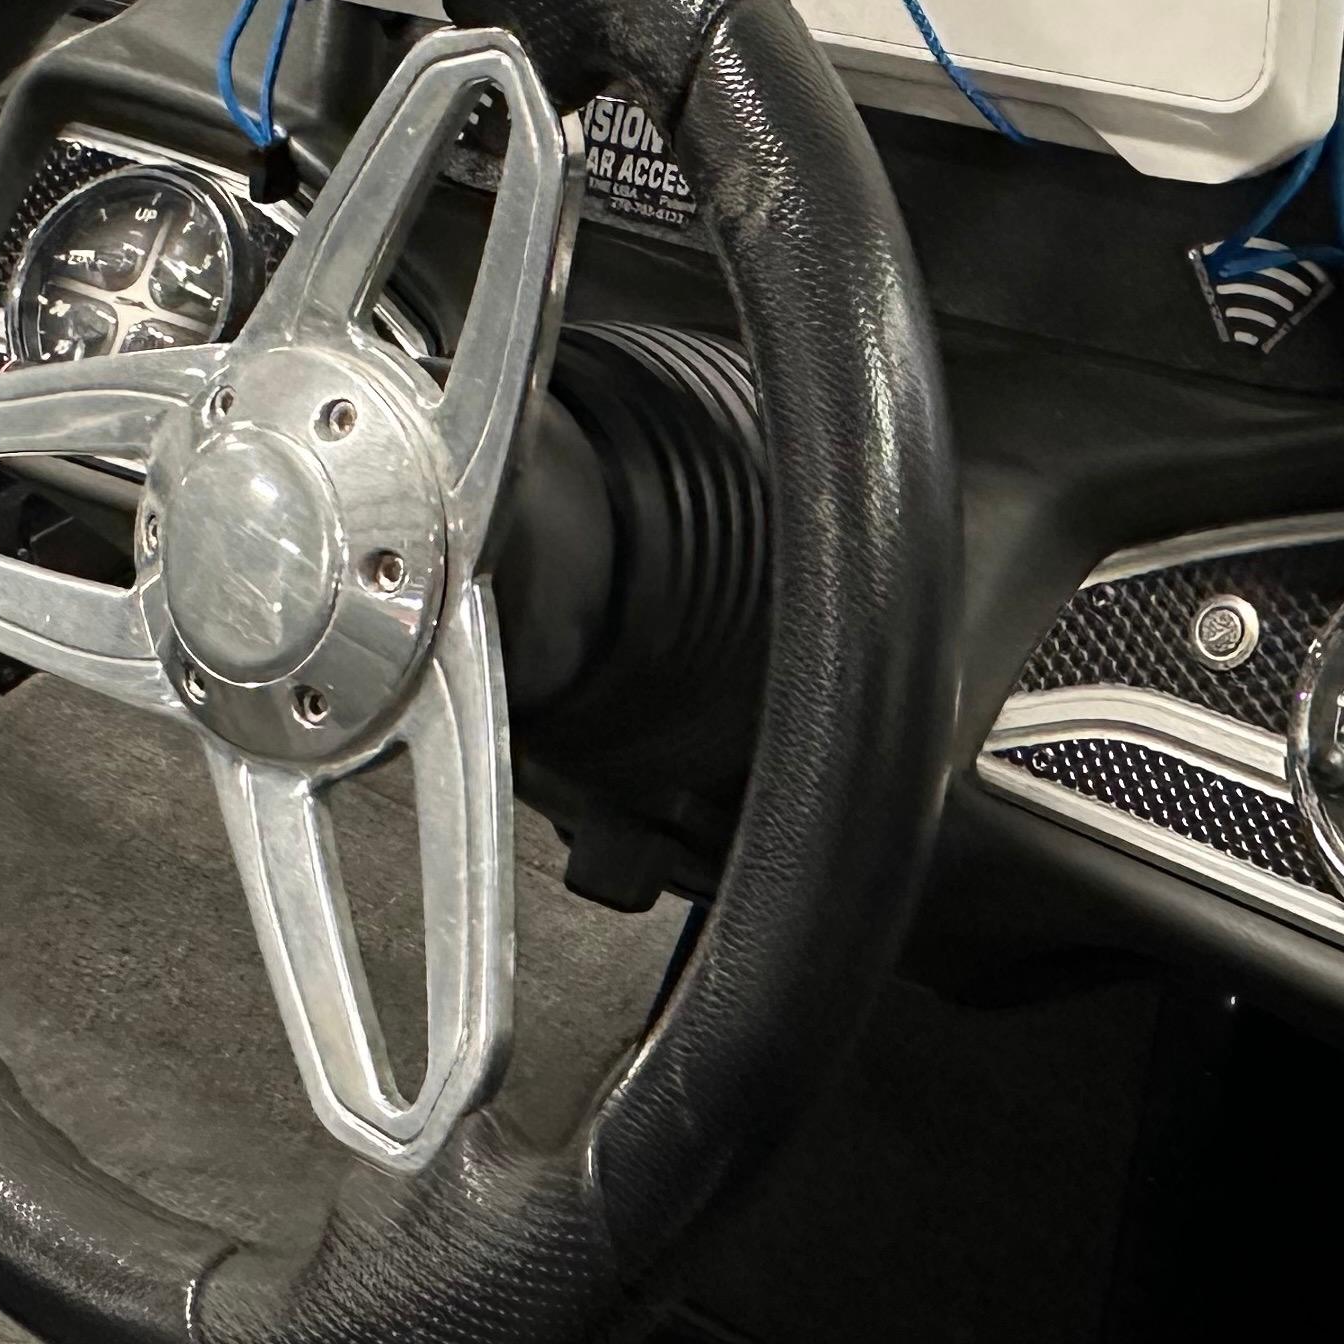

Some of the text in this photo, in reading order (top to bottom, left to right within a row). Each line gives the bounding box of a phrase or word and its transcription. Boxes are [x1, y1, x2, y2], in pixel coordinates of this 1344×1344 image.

[582, 96, 664, 154] ISION
[617, 153, 692, 197] ACCES
[134, 207, 158, 222] UP
